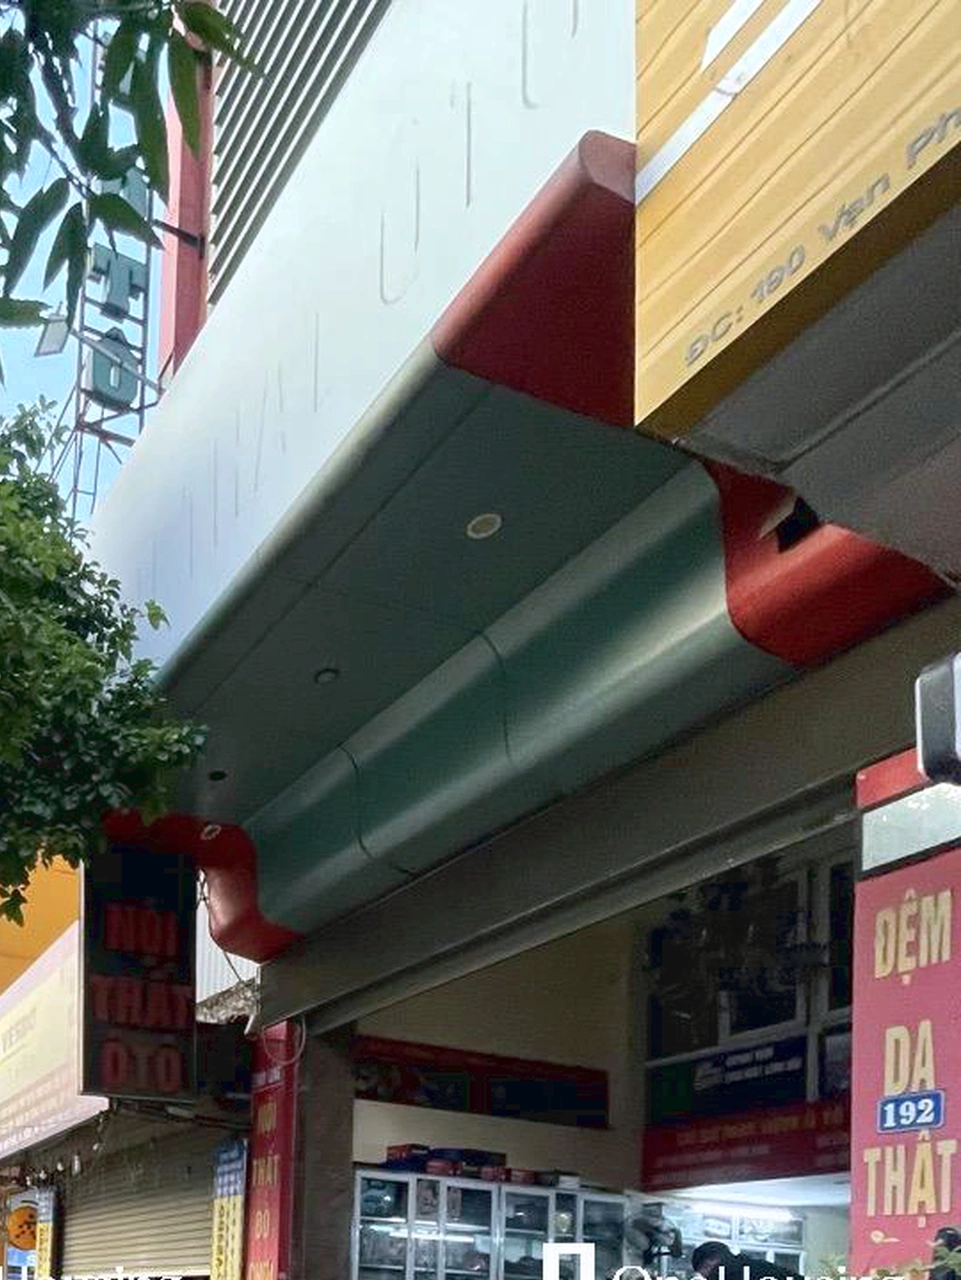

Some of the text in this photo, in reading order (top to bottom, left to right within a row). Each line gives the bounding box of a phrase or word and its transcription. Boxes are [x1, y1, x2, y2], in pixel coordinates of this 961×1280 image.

[874, 887, 953, 985] ĐỆM
[884, 1018, 936, 1097] DA
[883, 1098, 935, 1128] 192
[862, 1128, 958, 1228] THẬT
